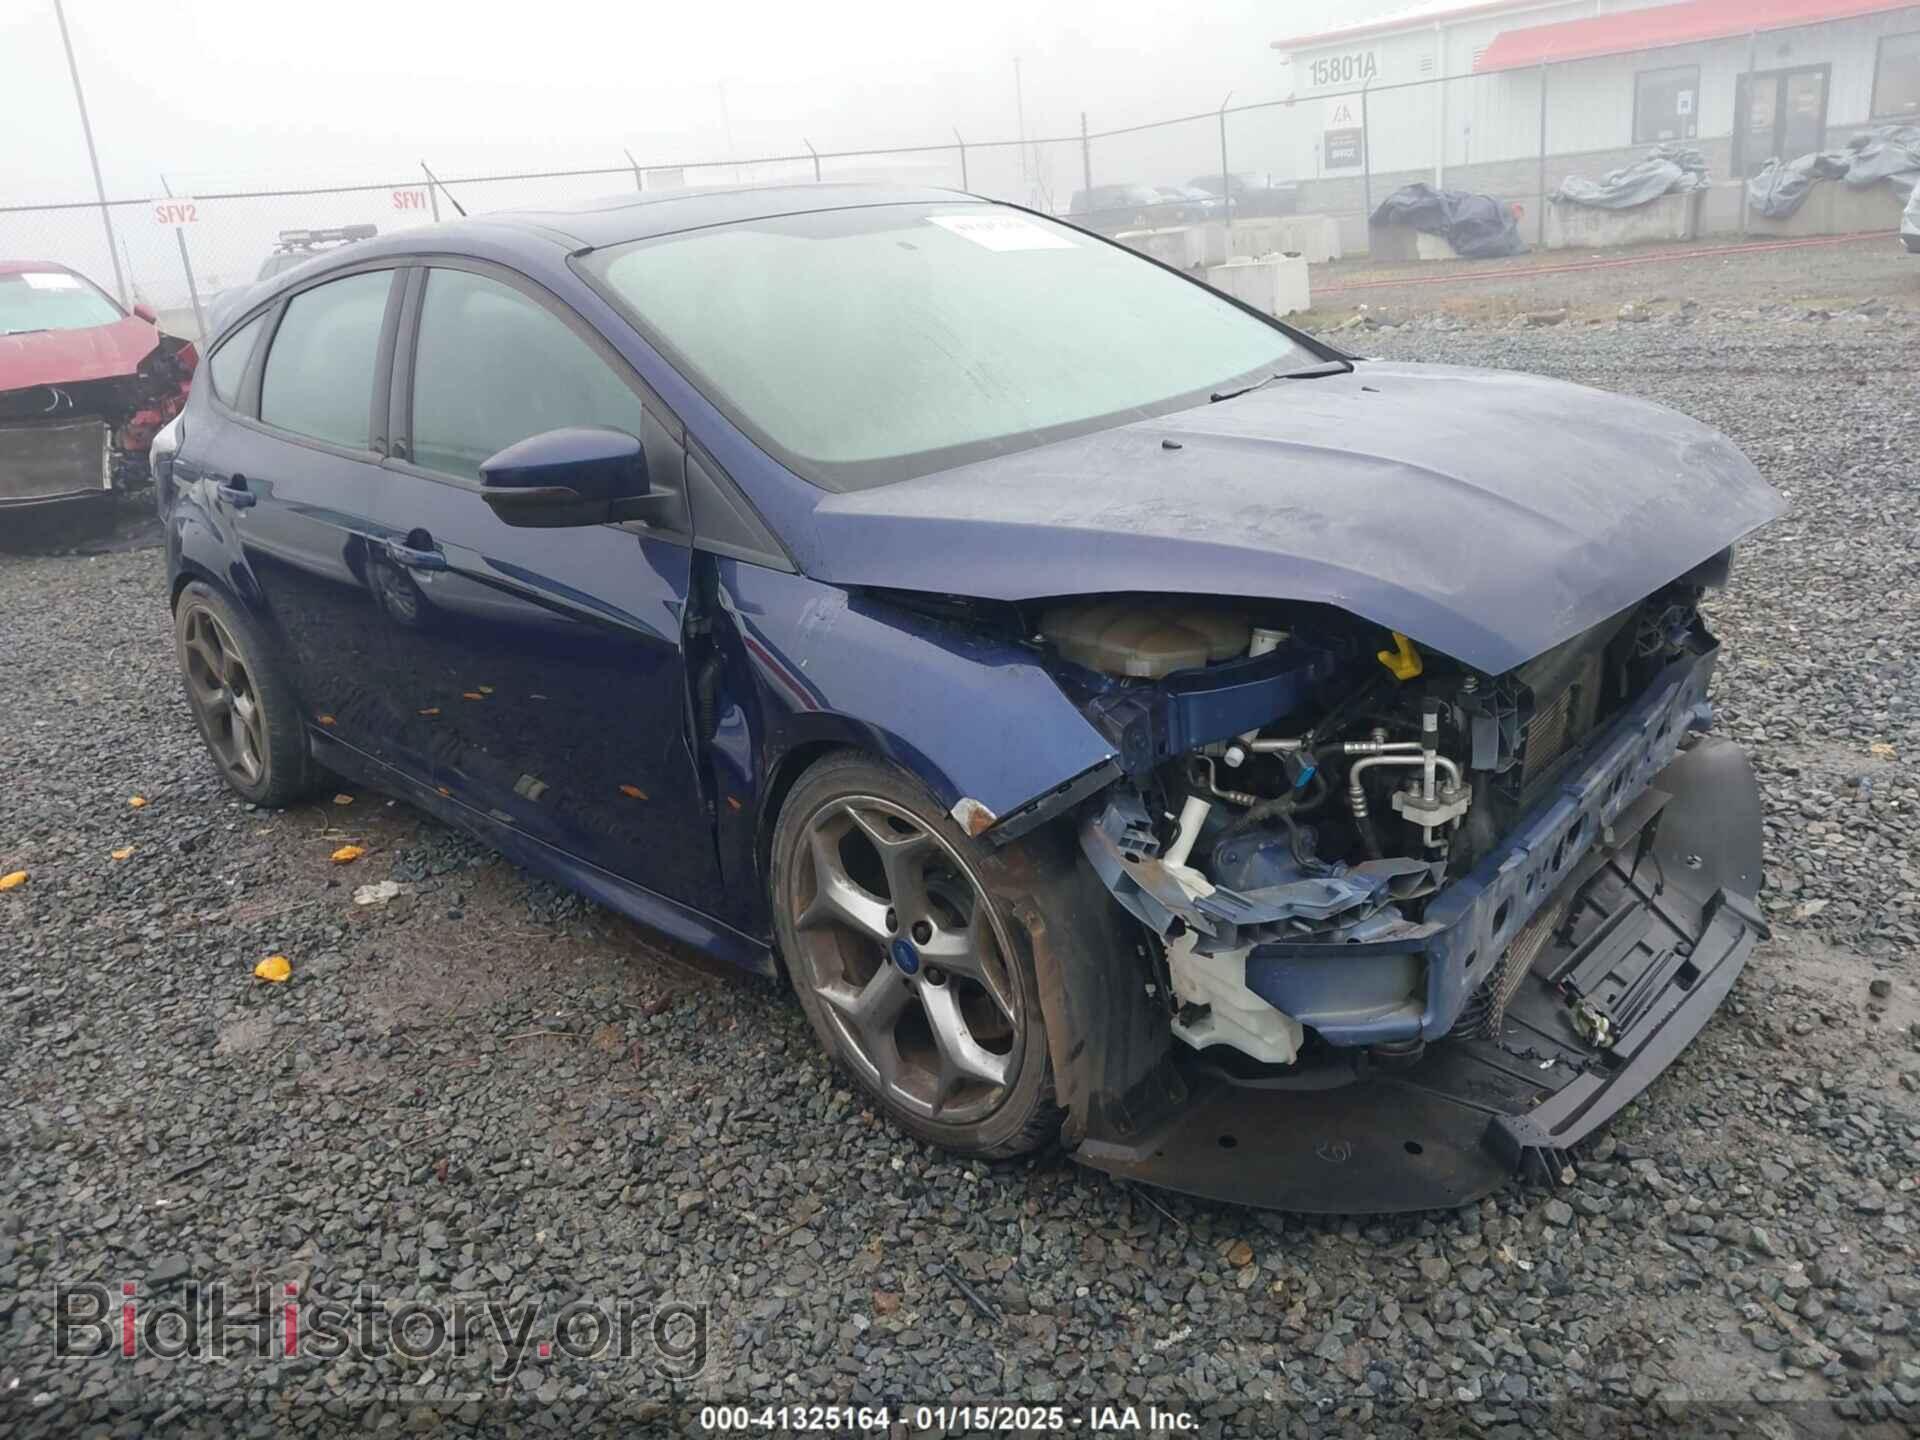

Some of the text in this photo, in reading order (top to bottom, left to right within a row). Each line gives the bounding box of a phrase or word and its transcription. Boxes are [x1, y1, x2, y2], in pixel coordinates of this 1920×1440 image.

[1309, 51, 1377, 86] 15801A
[392, 190, 427, 209] SFV1
[155, 204, 200, 224] SFV2
